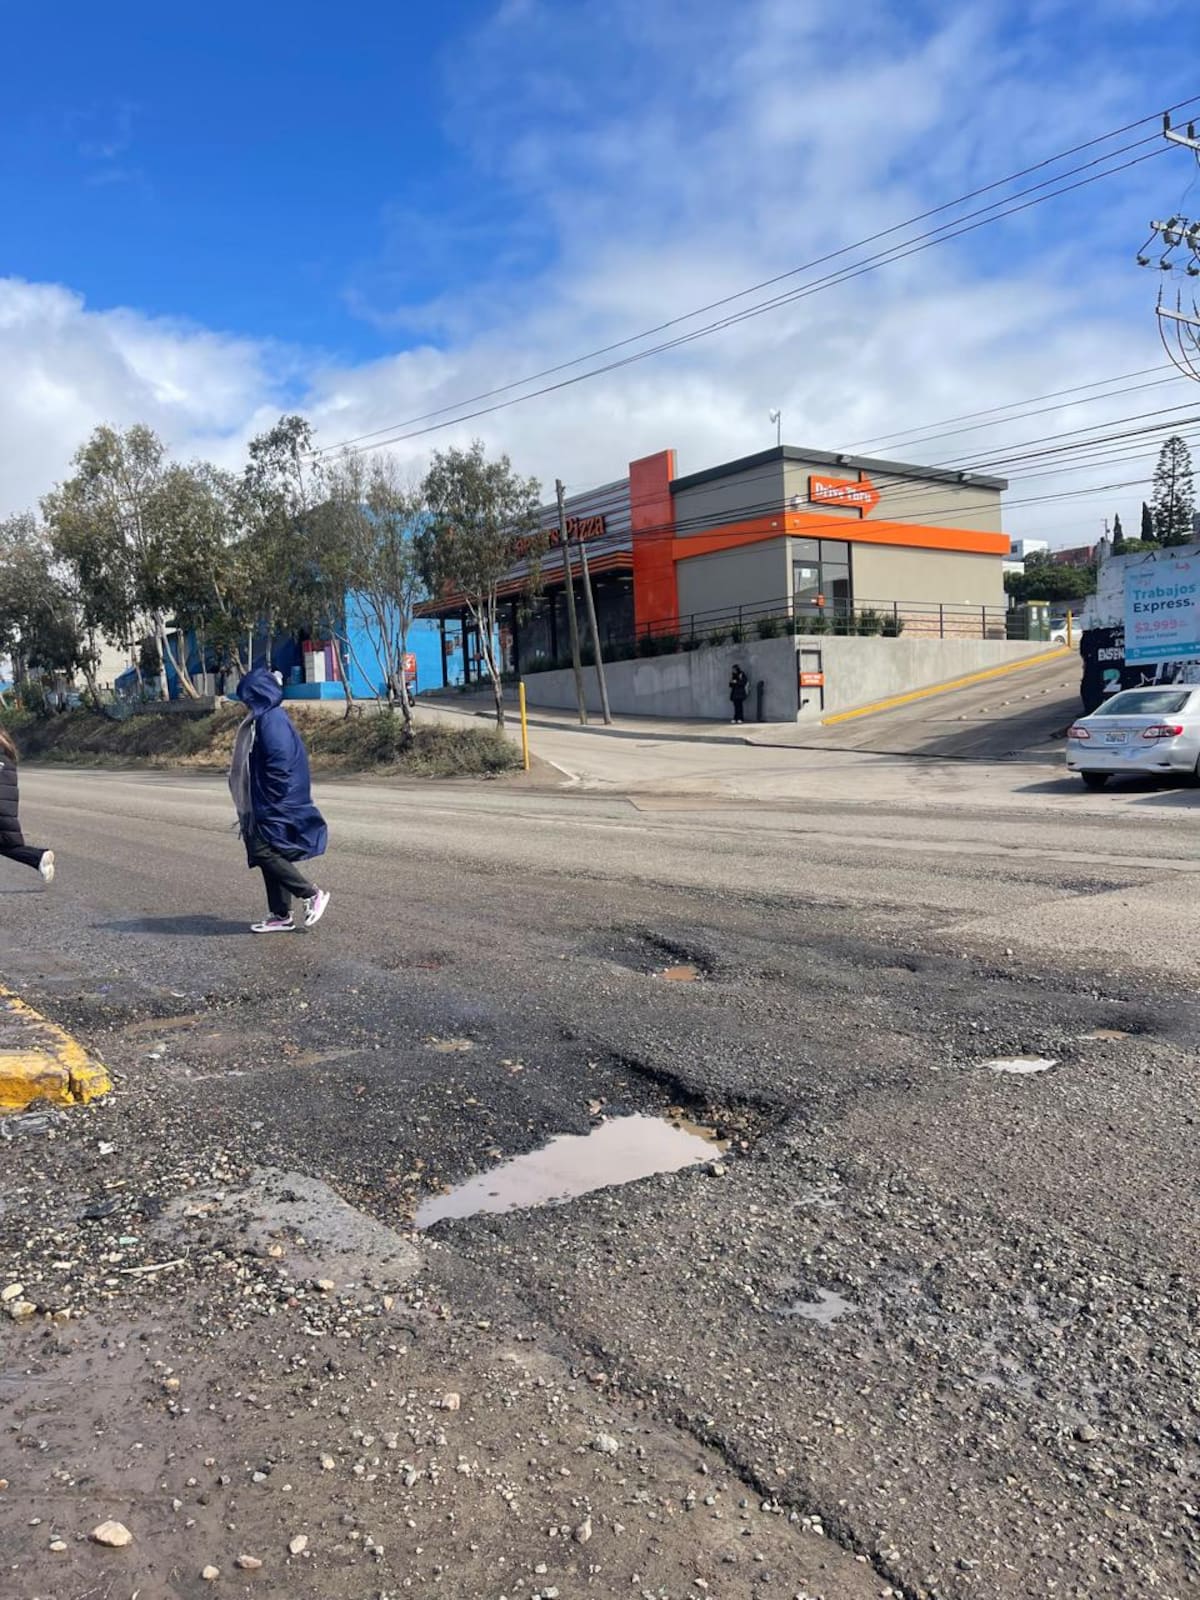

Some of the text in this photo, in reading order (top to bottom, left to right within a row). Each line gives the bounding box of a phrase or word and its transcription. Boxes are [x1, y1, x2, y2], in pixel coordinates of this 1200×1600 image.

[565, 515, 605, 540] Pizza
[1133, 583, 1196, 601] Trabajos
[1133, 598, 1195, 614] Express.
[1102, 668, 1122, 693] 2
